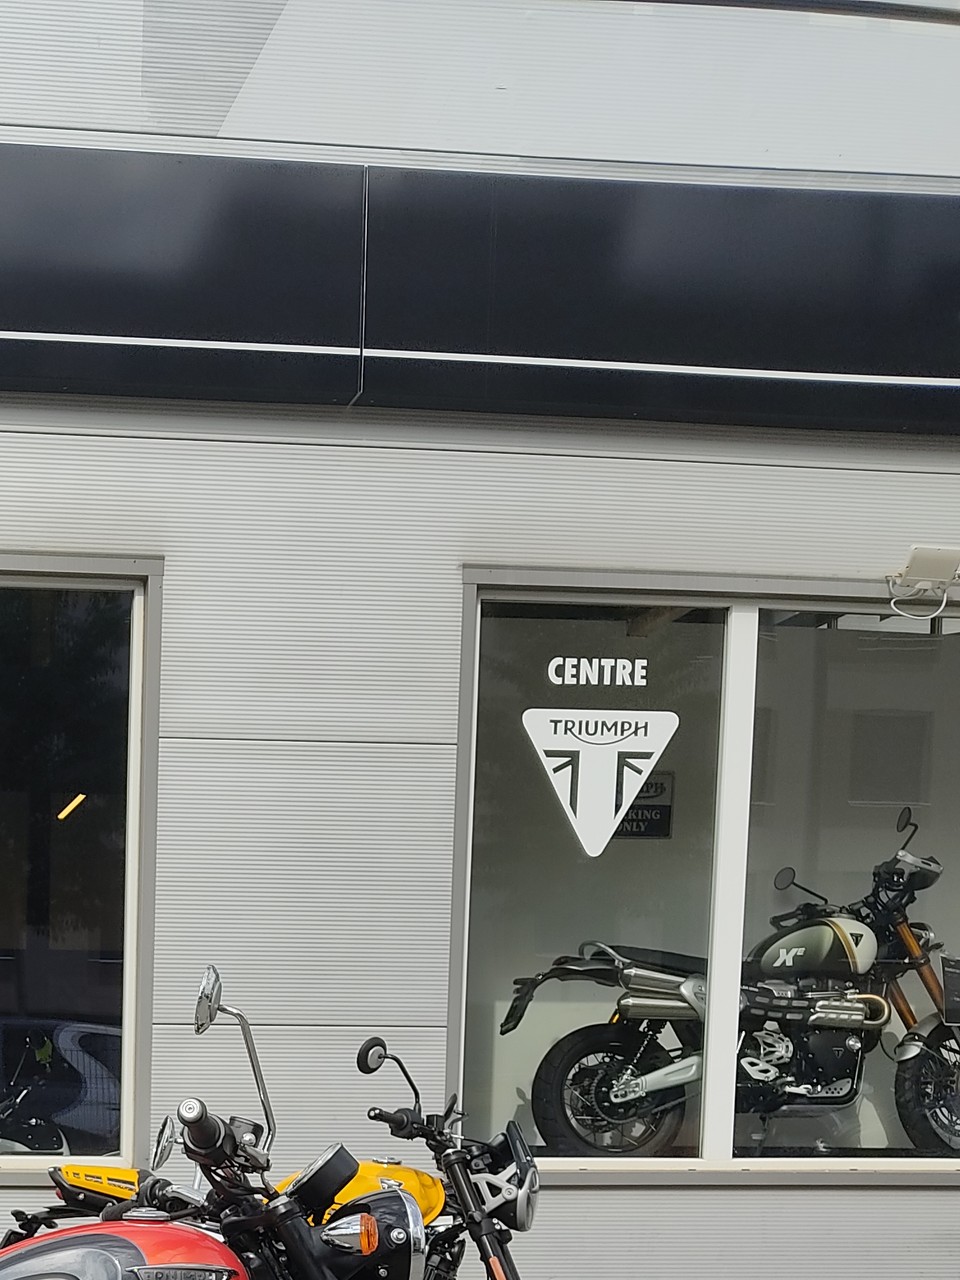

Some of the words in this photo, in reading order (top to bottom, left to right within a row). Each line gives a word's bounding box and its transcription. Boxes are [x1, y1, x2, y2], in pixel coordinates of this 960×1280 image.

[548, 657, 648, 686] CENTRE
[549, 719, 649, 744] TRIUMPH
[624, 809, 661, 820] KING
